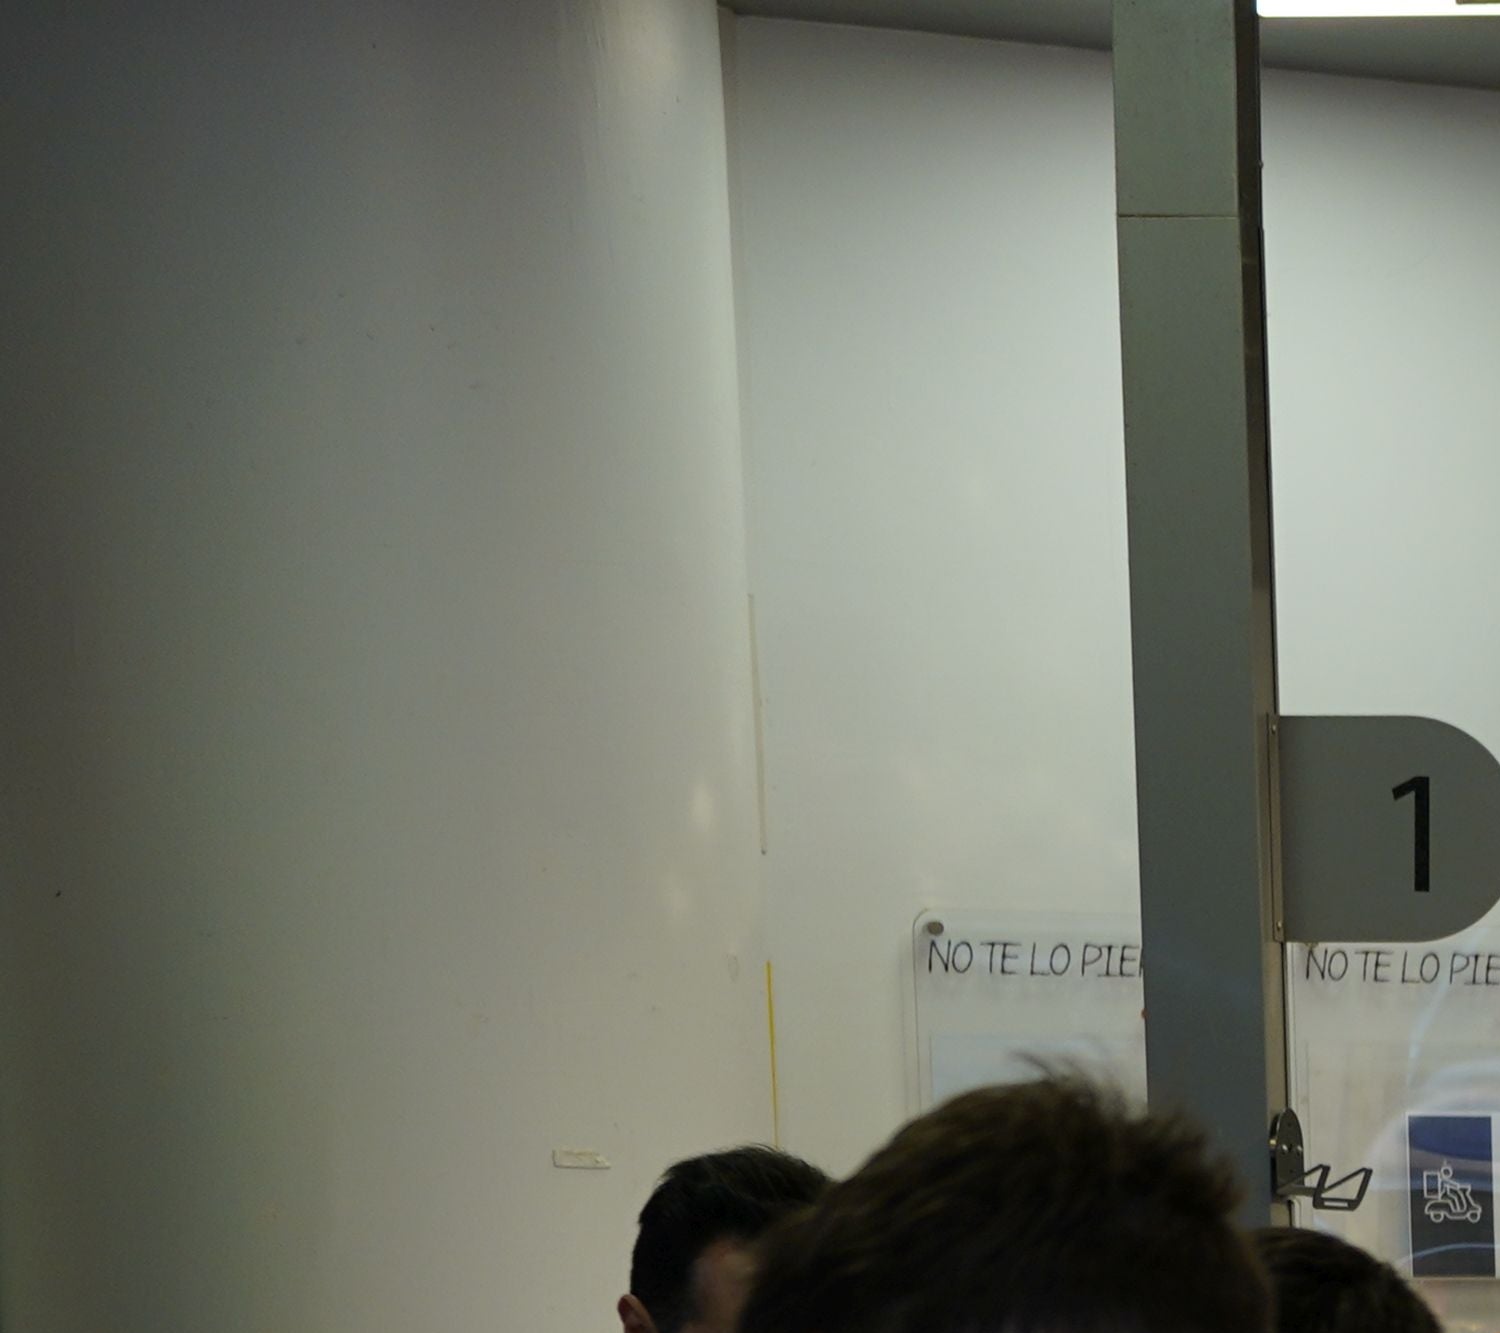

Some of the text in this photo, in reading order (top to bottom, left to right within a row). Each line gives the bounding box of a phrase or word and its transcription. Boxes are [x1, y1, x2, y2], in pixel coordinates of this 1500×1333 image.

[1391, 776, 1431, 892] 1
[929, 939, 1143, 977] NO TE LO PIE
[1305, 949, 1348, 981] NO
[1354, 951, 1394, 983] TE
[1401, 952, 1440, 984] LO
